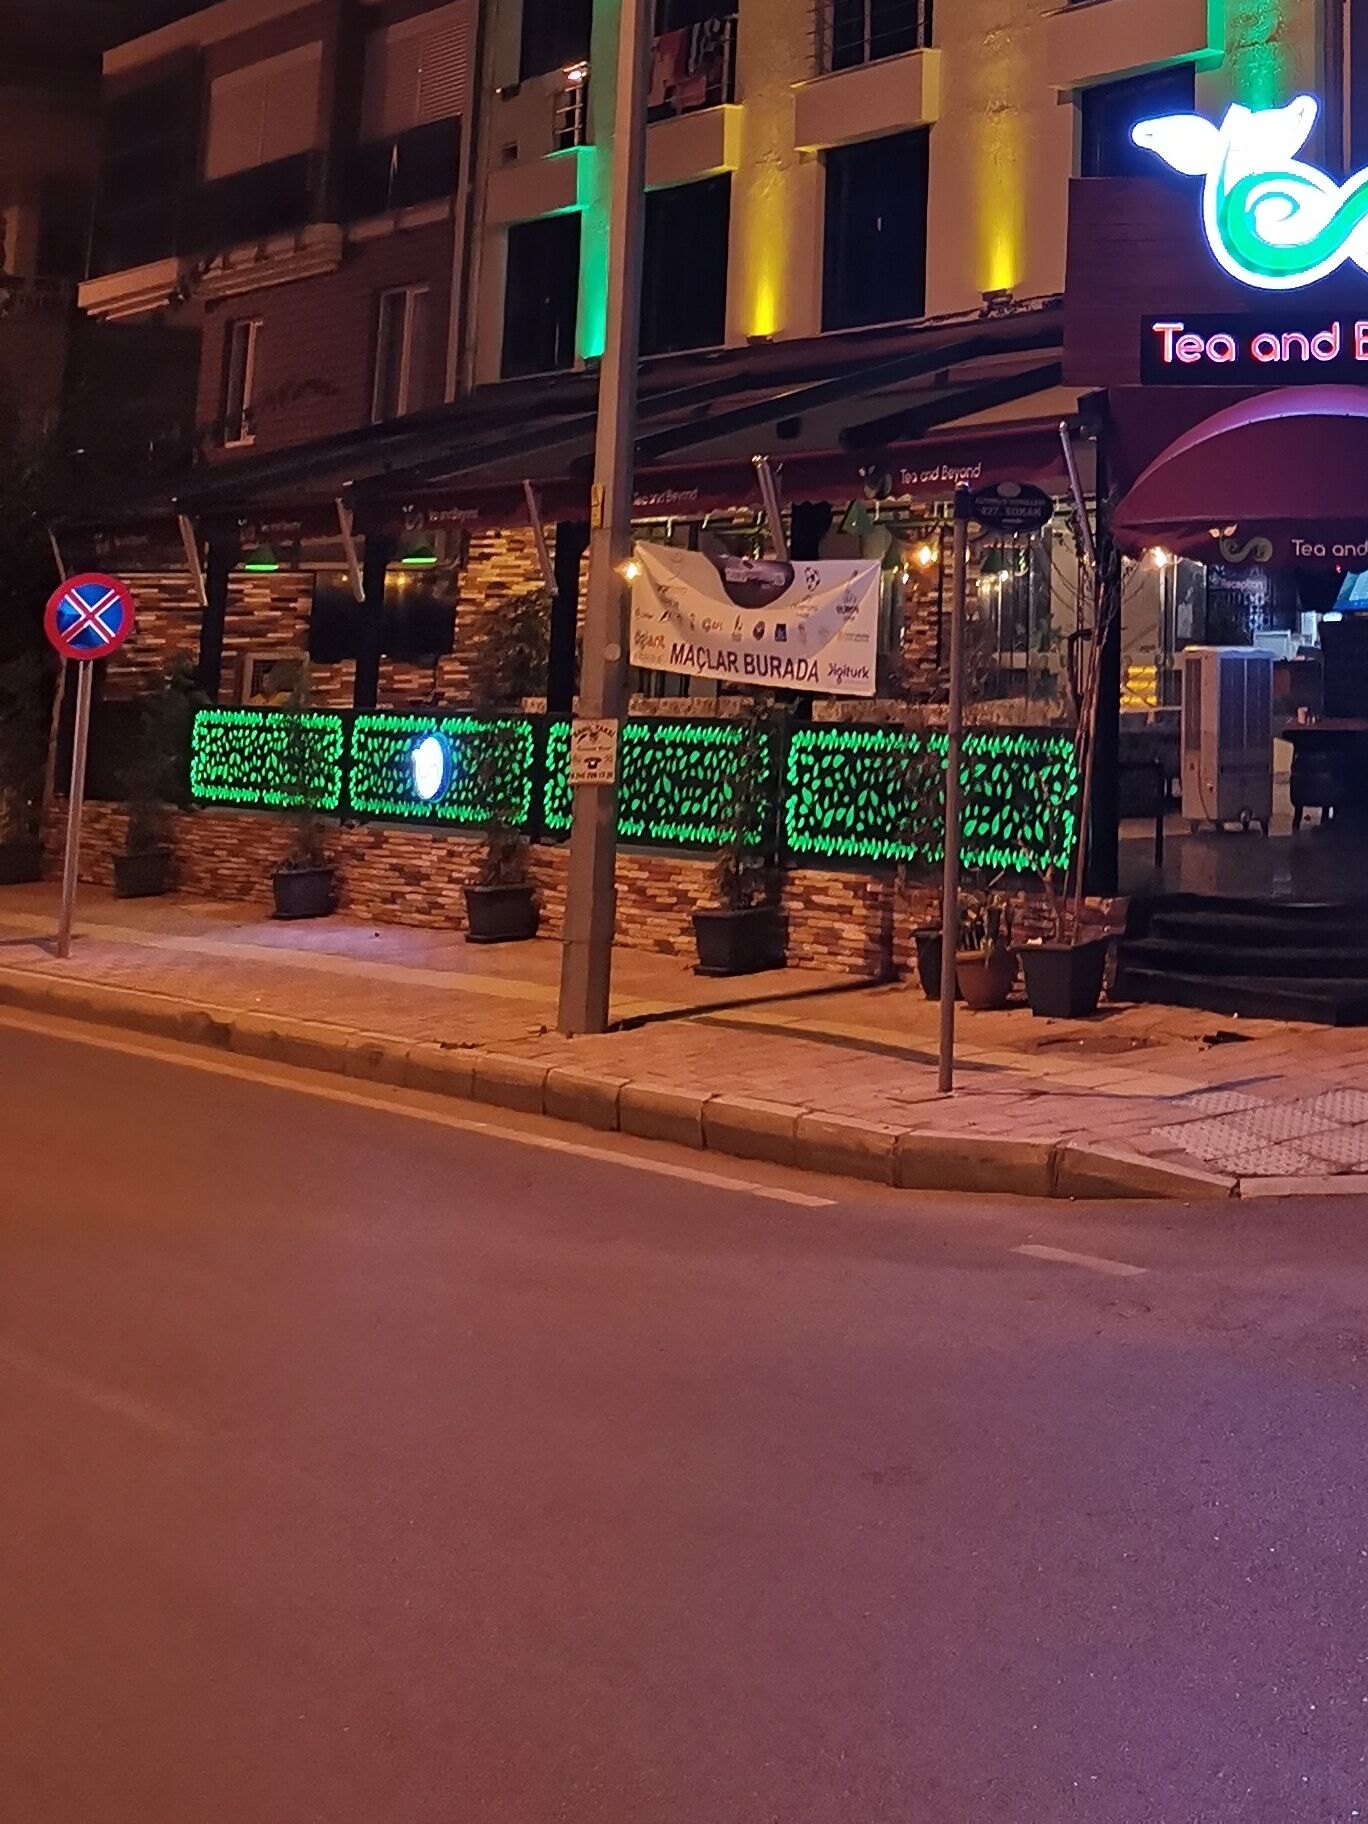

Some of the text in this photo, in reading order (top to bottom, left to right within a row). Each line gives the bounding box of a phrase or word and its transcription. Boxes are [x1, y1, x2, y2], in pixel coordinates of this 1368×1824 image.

[1152, 322, 1237, 363] Tea
[1250, 321, 1340, 363] and
[900, 458, 983, 485] Tea and Beyond
[1291, 538, 1326, 557] Tea
[1332, 539, 1368, 557] and
[670, 642, 820, 684] MAÇLAR BURADA
